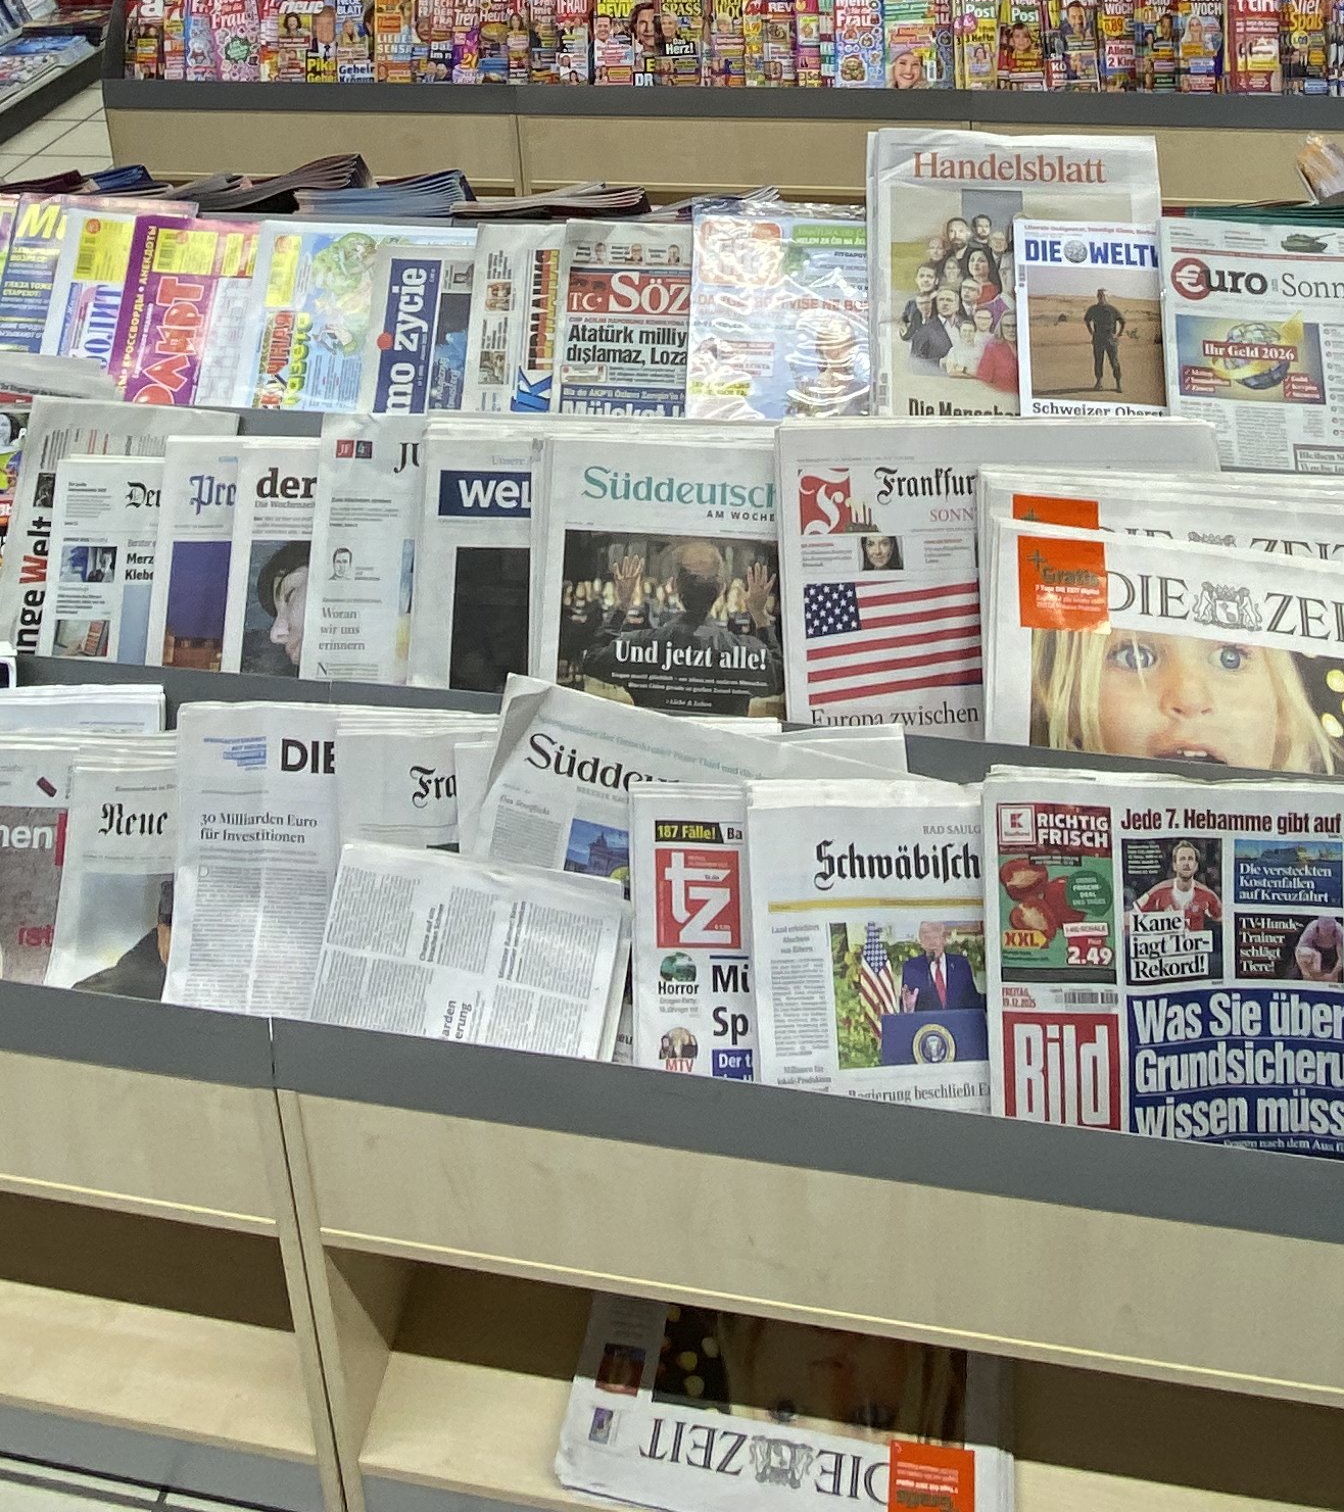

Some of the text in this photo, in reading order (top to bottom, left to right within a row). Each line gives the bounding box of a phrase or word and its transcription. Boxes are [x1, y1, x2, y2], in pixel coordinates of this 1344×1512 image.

[913, 150, 1106, 184] Handelsblatt
[1025, 239, 1062, 263] DIE
[568, 324, 688, 348] Atatürk milliy
[650, 349, 688, 365] Loza
[1204, 343, 1295, 361] Ihr Geld 2026
[1032, 402, 1110, 416] Schweizer
[256, 467, 317, 500] der
[706, 510, 725, 521] AM
[19, 516, 52, 585] Welt
[1108, 570, 1190, 621] DIE
[615, 639, 768, 671] Und jetzt alle!
[889, 703, 979, 728] zwischen
[98, 802, 170, 836] Neue
[200, 811, 318, 828] 30 Milliarden Euro
[1037, 812, 1110, 831] RICHTIG
[1121, 808, 1342, 835] Jede 7. Hebamme gibt auf
[200, 828, 306, 844] für Investitionen
[657, 824, 716, 841] 187 Fälle!
[1038, 828, 1108, 848] FRISCH
[1239, 863, 1333, 878] Die versteckten
[1239, 876, 1316, 890] Kostenfallen
[664, 851, 733, 945] tz
[1239, 888, 1329, 904] auf Kreuzfahrt
[1133, 913, 1182, 933] Kane
[1004, 931, 1041, 948] XXL
[1132, 934, 1210, 959] jagt Tor-
[1239, 932, 1286, 945] Trainer
[1067, 946, 1113, 965] 2.49
[1134, 954, 1206, 980] Rekord!
[657, 980, 699, 996] Horror
[711, 964, 750, 994] Mi
[712, 1006, 749, 1045] Sp
[1133, 999, 1202, 1045] Was
[1209, 992, 1263, 1039] Sie
[665, 1058, 694, 1073] MTV
[718, 1053, 743, 1069] Der
[1014, 1023, 1110, 1128] Bild
[1135, 1093, 1249, 1140] wissen
[638, 1417, 748, 1476] ZEIT
